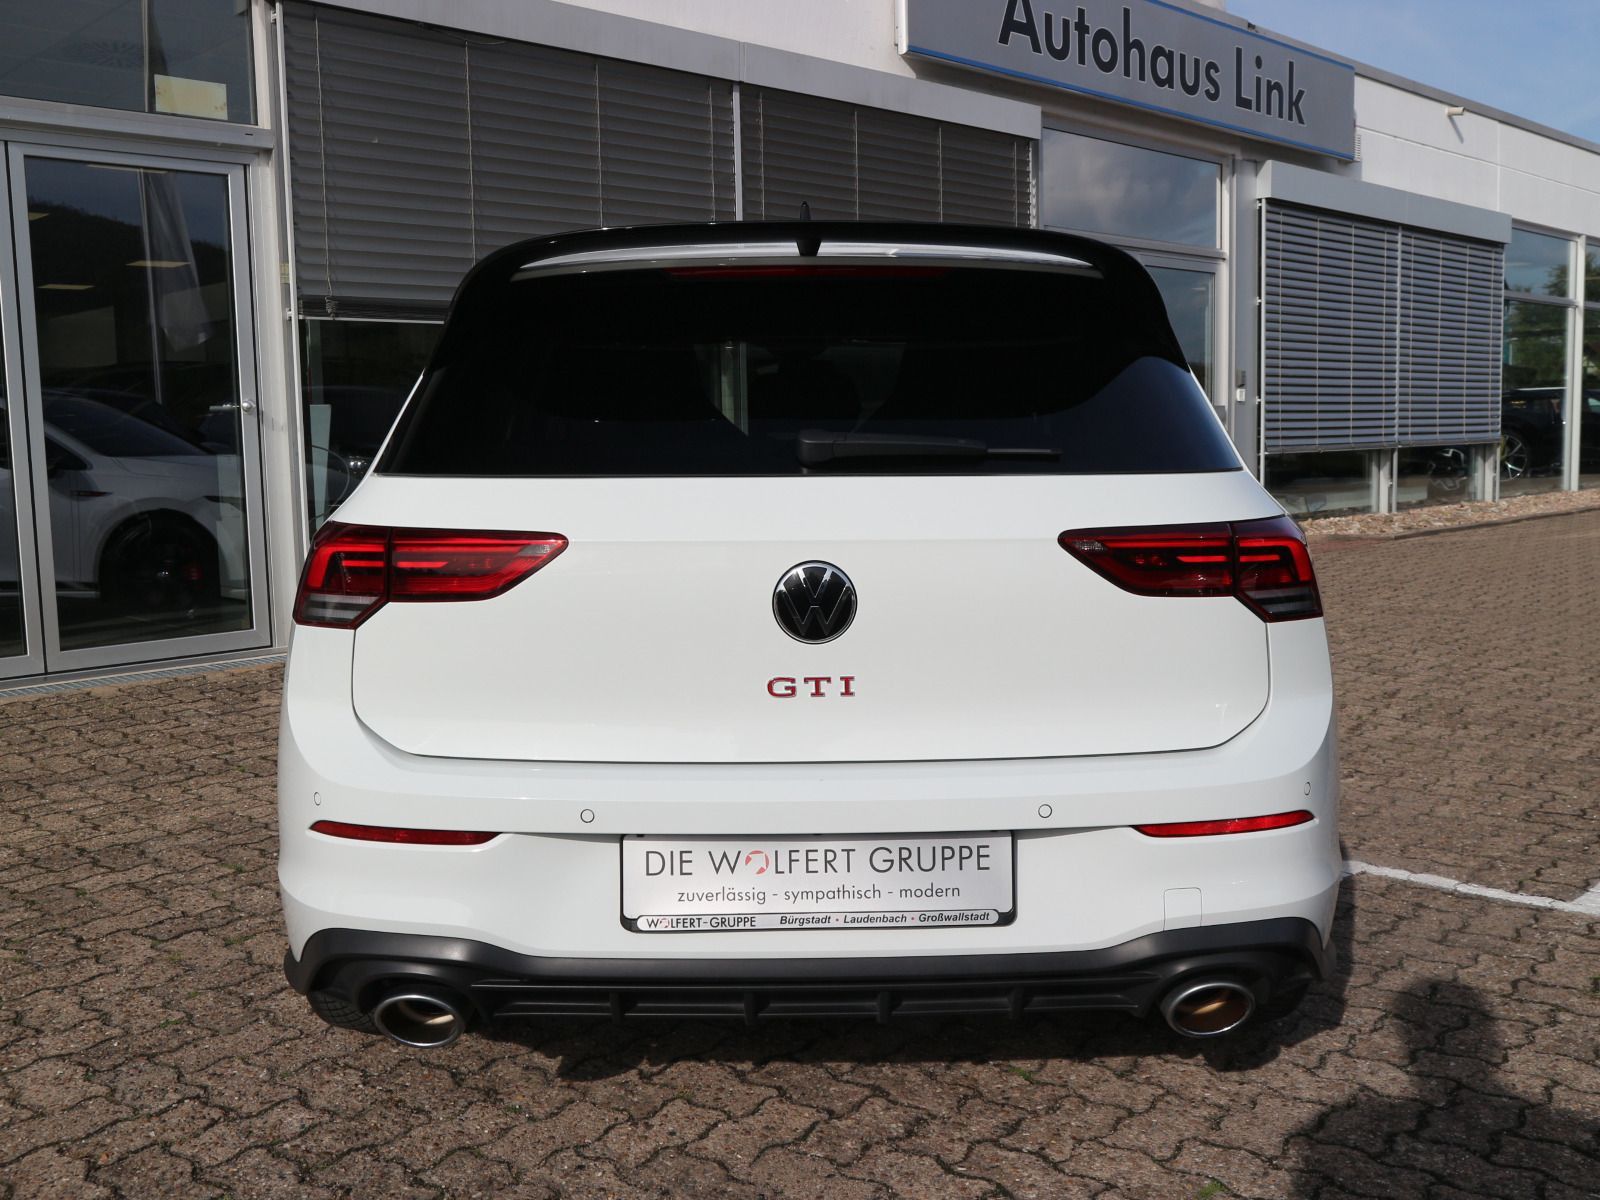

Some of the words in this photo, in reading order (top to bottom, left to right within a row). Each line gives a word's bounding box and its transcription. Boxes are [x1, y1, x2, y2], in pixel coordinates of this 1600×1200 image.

[998, 0, 1221, 102] Autohaus
[1235, 47, 1306, 126] Link
[772, 560, 857, 645] VW
[767, 676, 856, 698] GTI
[645, 850, 693, 876] DIE
[708, 848, 856, 876] WOLFERT
[869, 845, 990, 873] GRUPPE
[677, 886, 766, 904] zuverlässig
[784, 883, 881, 904] sympathisch
[899, 884, 960, 899] modern
[779, 915, 831, 926] Bürgstadt
[843, 913, 907, 924] Laudenbach
[918, 911, 990, 924] Großwallstadt
